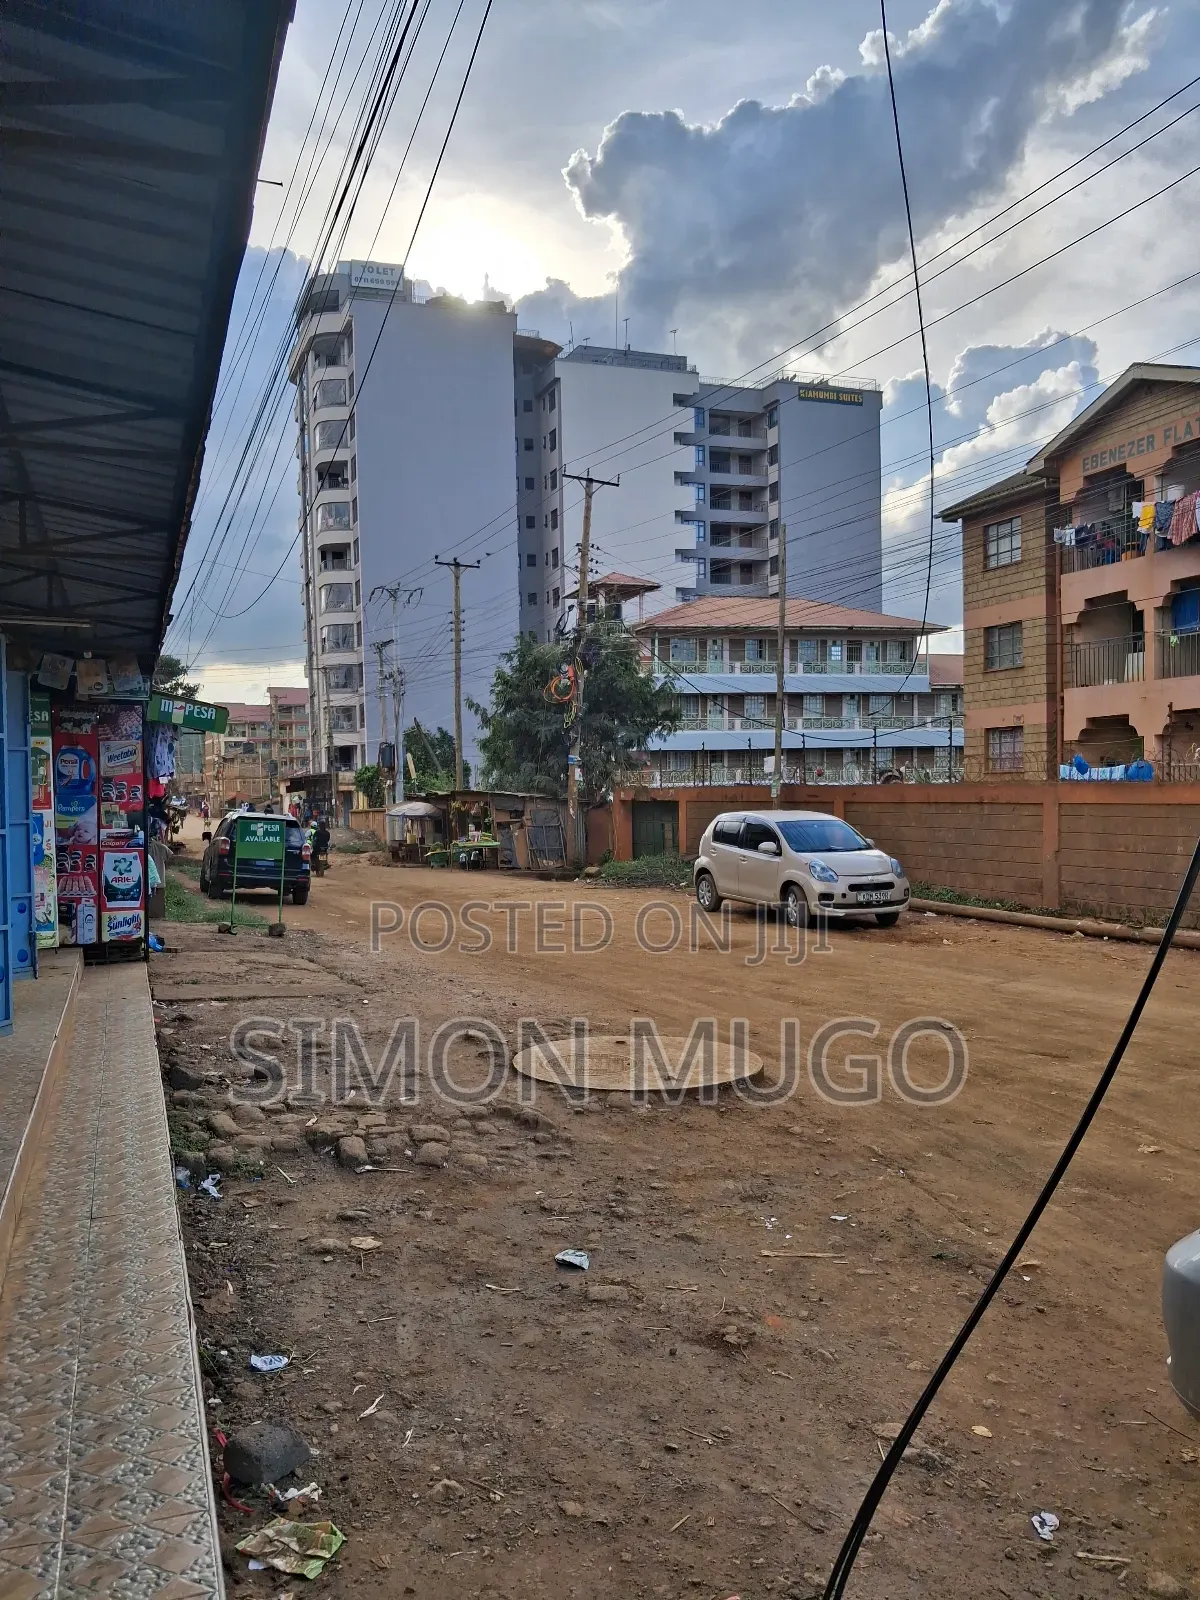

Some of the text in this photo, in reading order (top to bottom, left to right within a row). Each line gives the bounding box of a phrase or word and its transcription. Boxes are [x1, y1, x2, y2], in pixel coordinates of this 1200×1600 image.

[361, 264, 395, 276] TO LET
[839, 393, 863, 403] SUITES
[1083, 434, 1155, 474] EBENEZER
[107, 747, 137, 763] Weetabix
[57, 803, 85, 812] Pampers
[101, 839, 126, 847] Colgate
[245, 835, 281, 843] AVAILABLE
[106, 913, 140, 932] Sunlight
